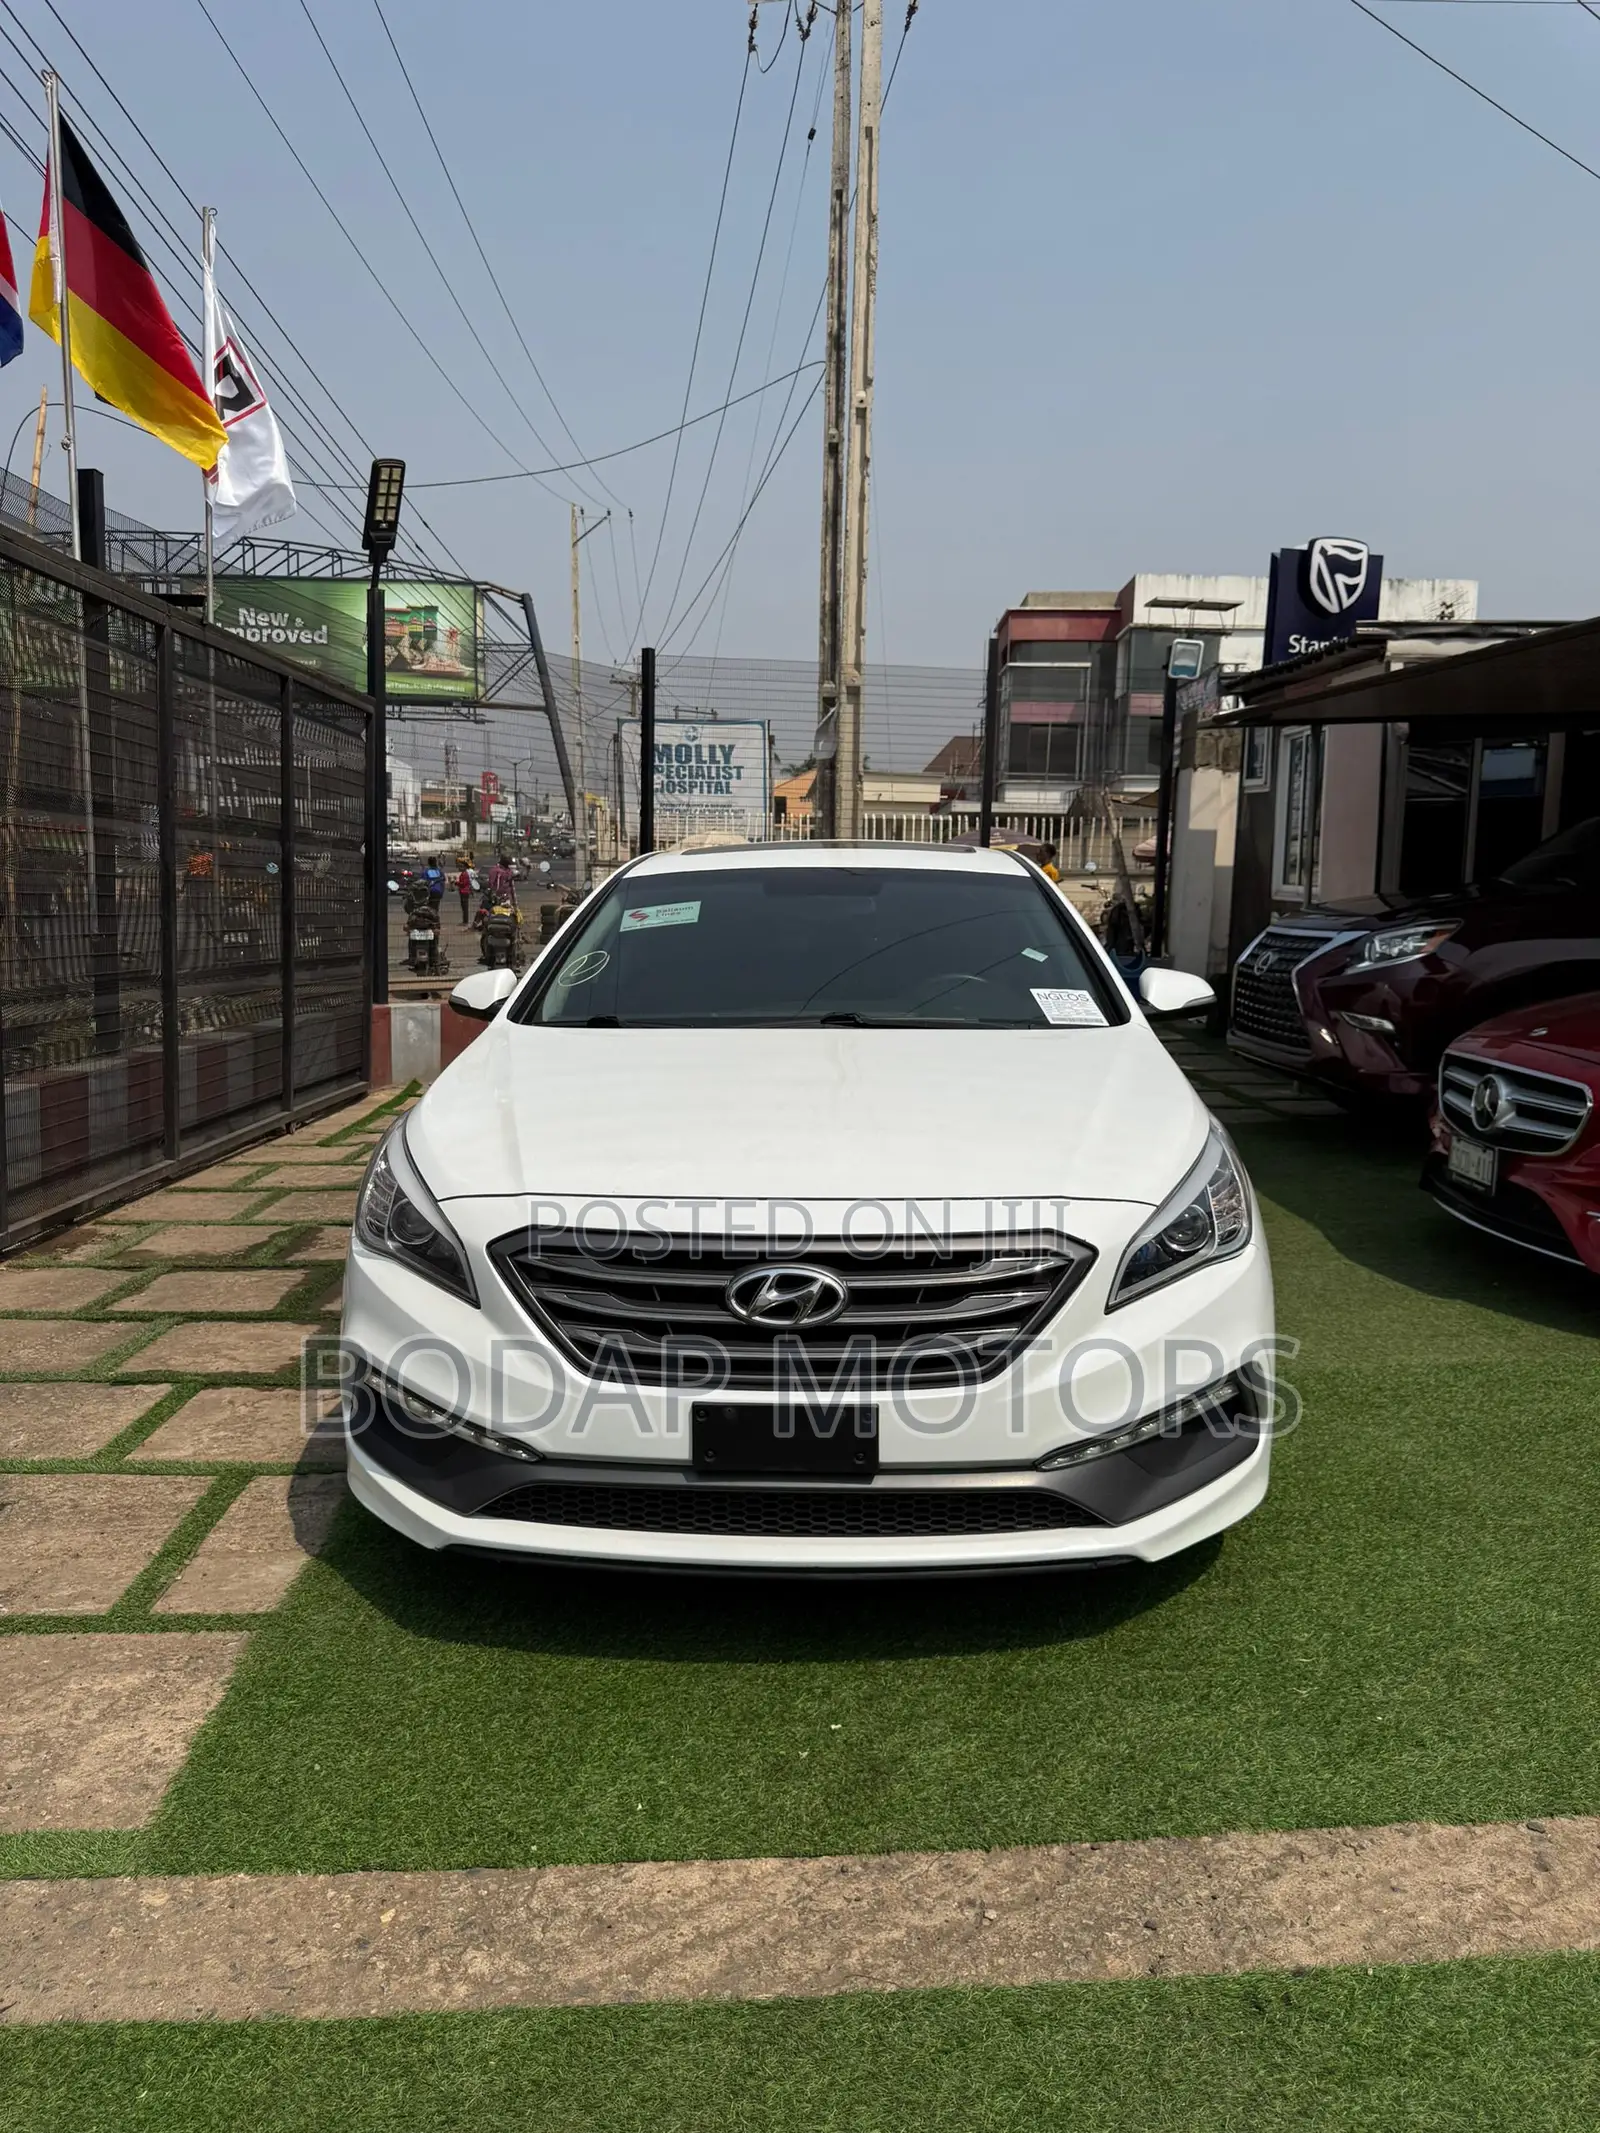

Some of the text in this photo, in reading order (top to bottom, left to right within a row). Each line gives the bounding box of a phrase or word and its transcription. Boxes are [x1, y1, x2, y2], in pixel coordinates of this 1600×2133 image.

[238, 607, 305, 628] New &
[216, 623, 328, 644] proved
[654, 743, 736, 765] MOLLY
[654, 764, 745, 781] PECIALIST
